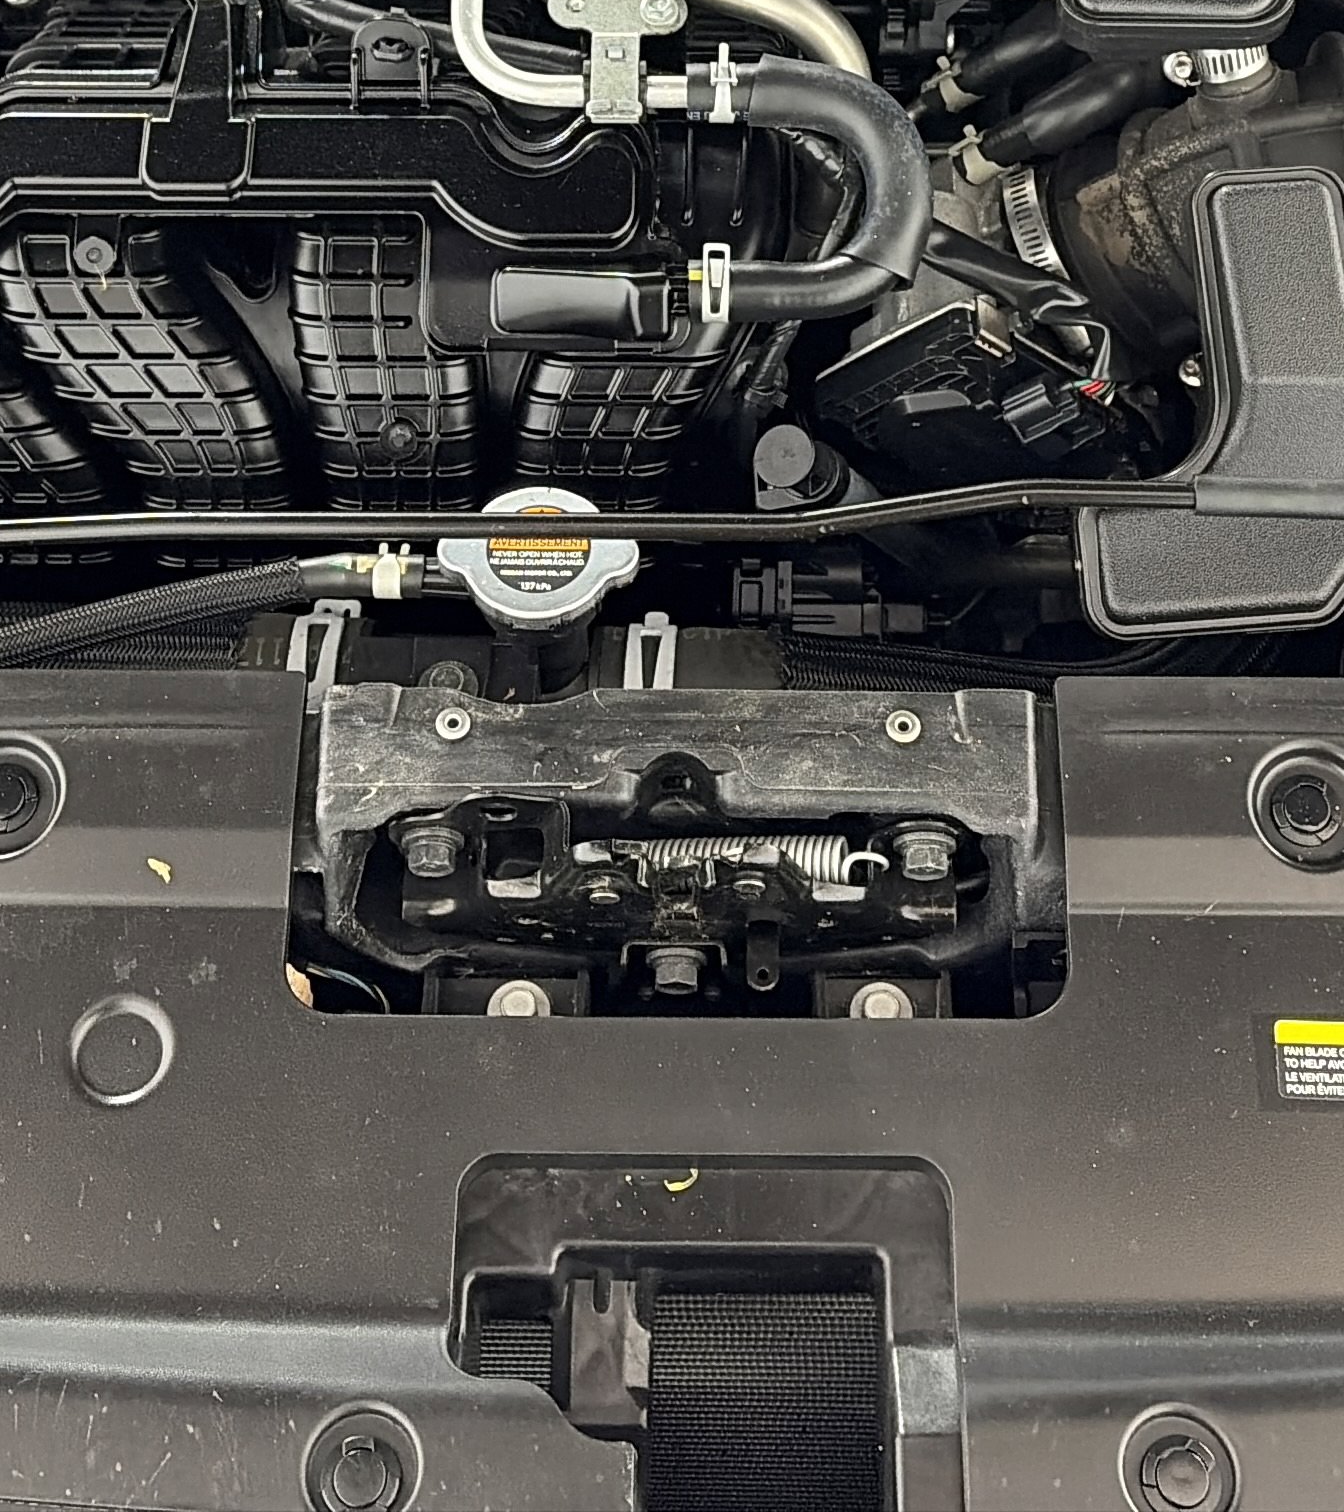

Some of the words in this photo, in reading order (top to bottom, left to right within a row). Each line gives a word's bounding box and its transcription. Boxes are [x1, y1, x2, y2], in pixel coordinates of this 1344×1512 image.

[493, 537, 584, 548] AVERTISSEMENT
[1284, 1047, 1303, 1057] FAN
[1305, 1048, 1338, 1058] BLADE
[1284, 1058, 1298, 1069] TO
[1301, 1060, 1326, 1070] HELP
[1285, 1072, 1297, 1082] LE
[1286, 1084, 1315, 1096] POUR
